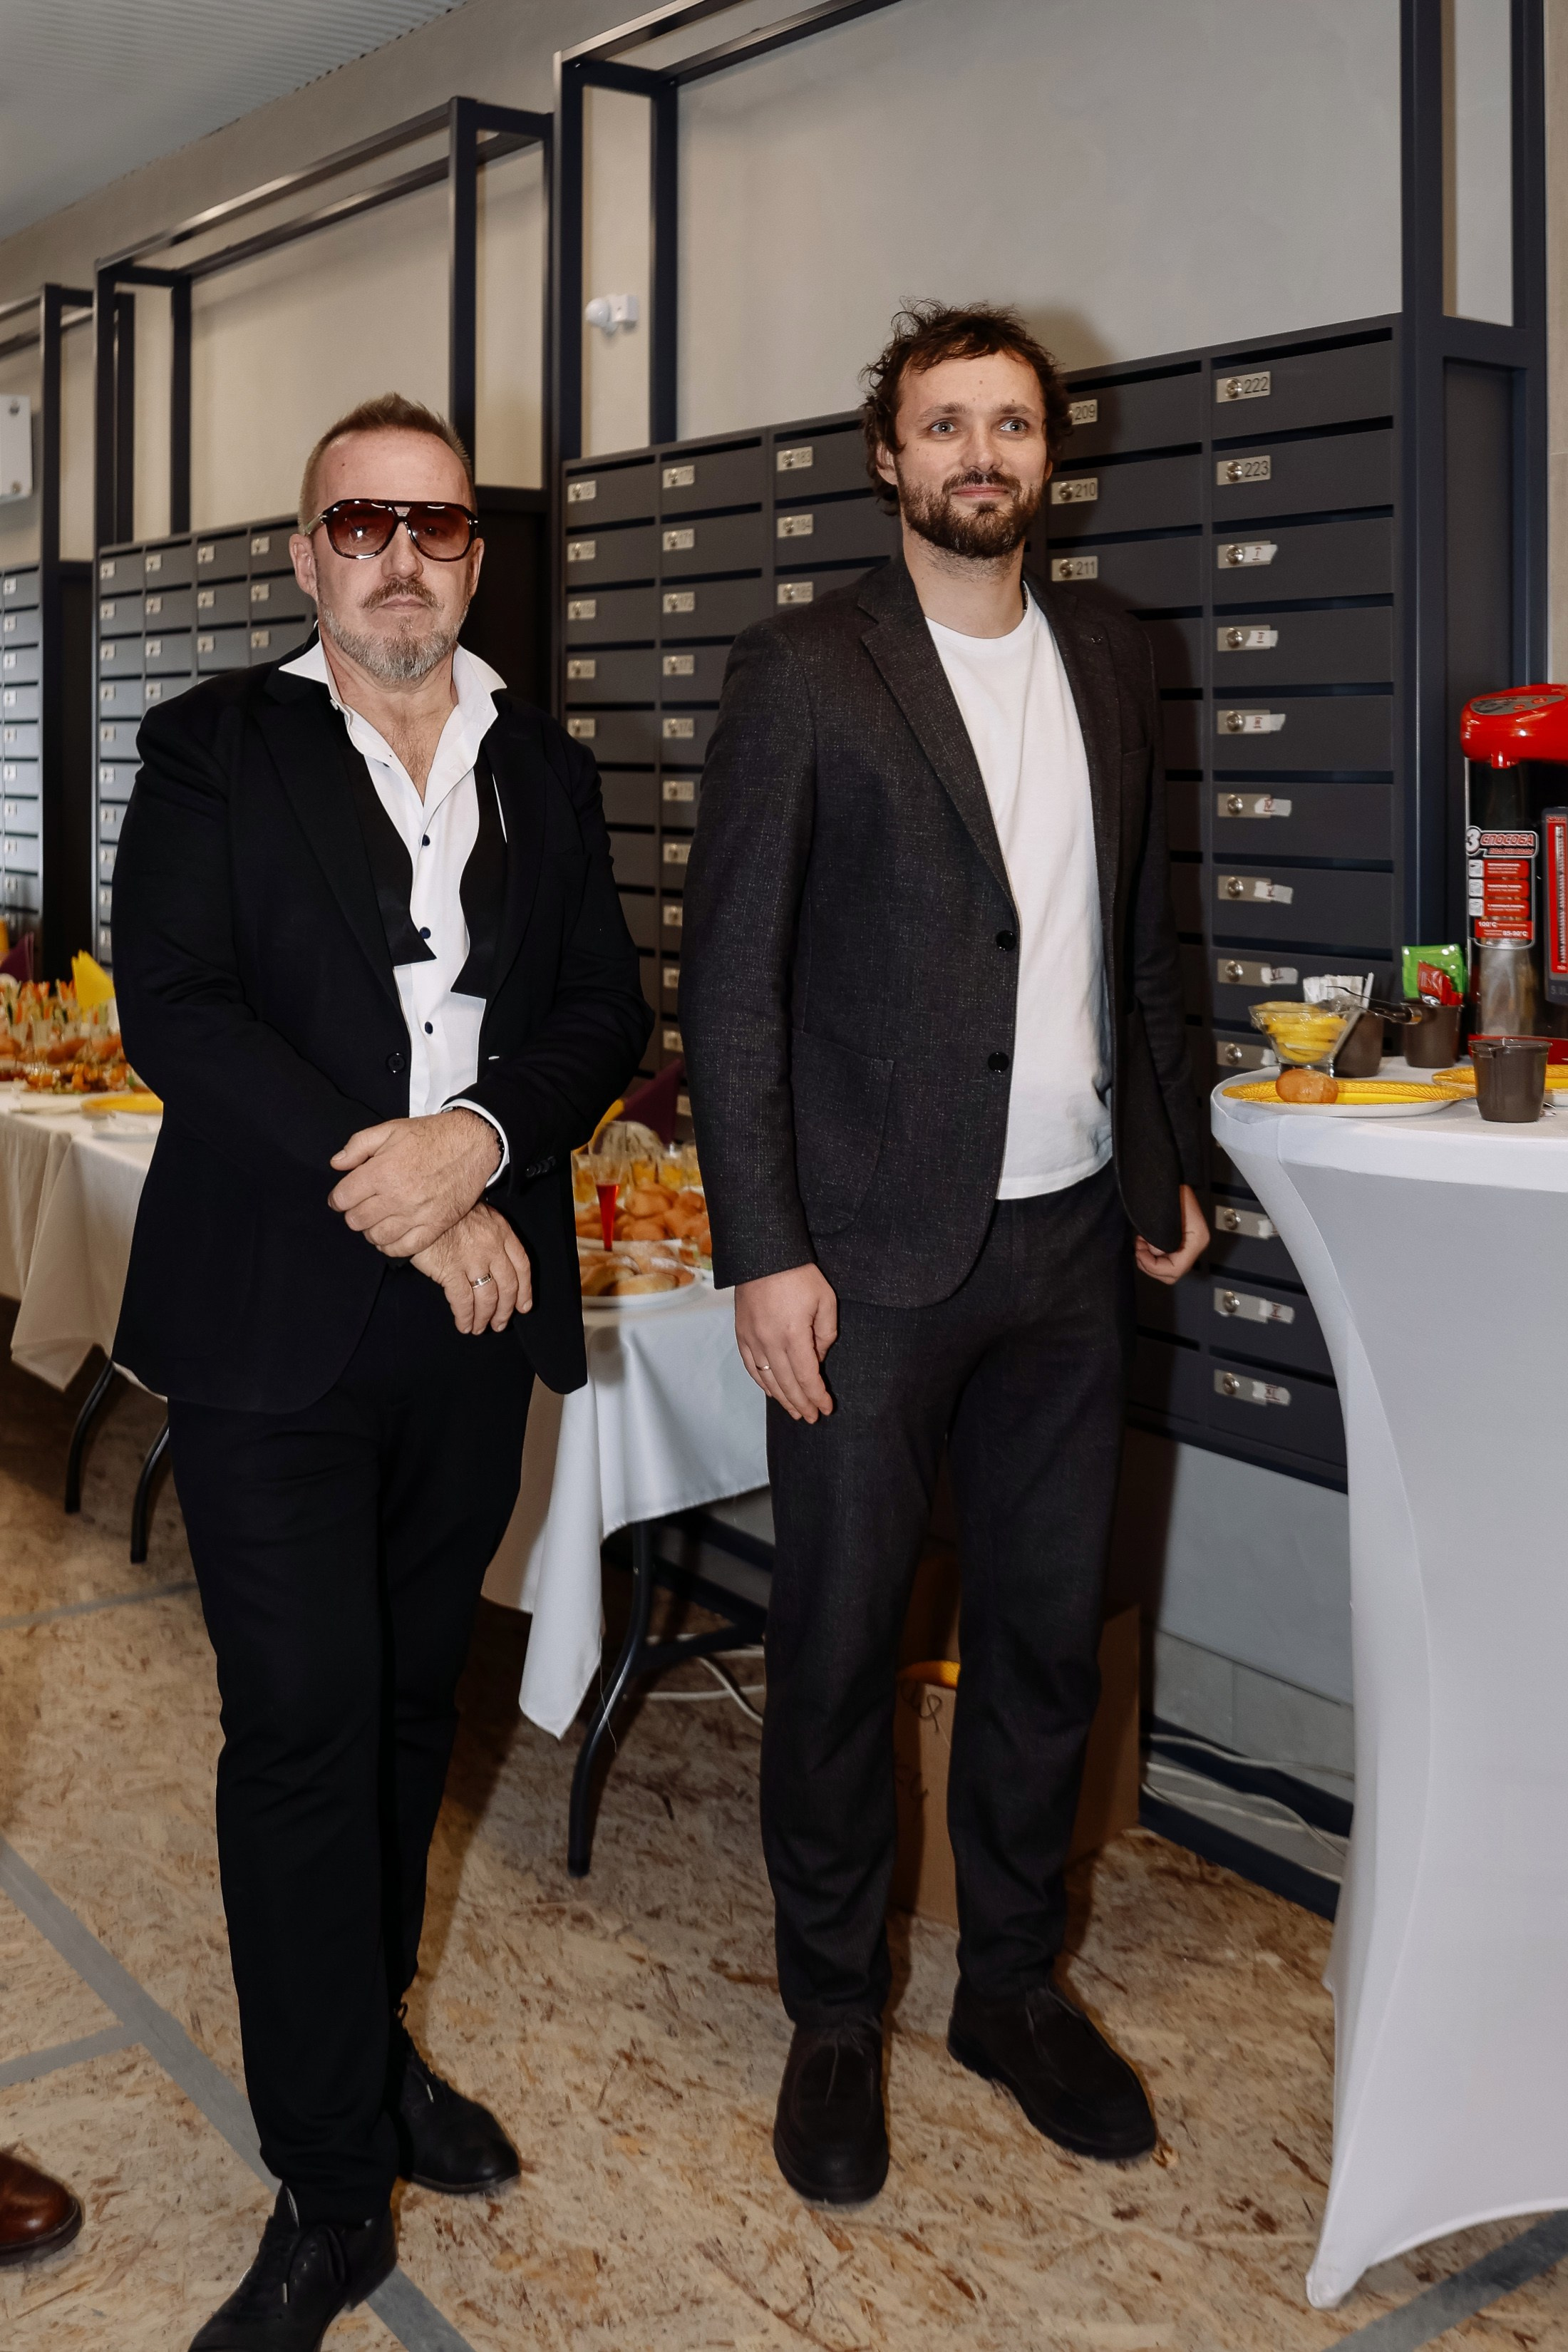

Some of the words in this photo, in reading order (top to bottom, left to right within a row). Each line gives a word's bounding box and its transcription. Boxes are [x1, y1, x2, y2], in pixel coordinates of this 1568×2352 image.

[1244, 376, 1269, 394] 222
[1075, 404, 1095, 420] 209
[1244, 460, 1269, 478] 223
[1075, 482, 1096, 497] 210
[1076, 561, 1095, 576] 211
[1466, 828, 1480, 852] 3
[1481, 833, 1535, 847] СПОСОБА
